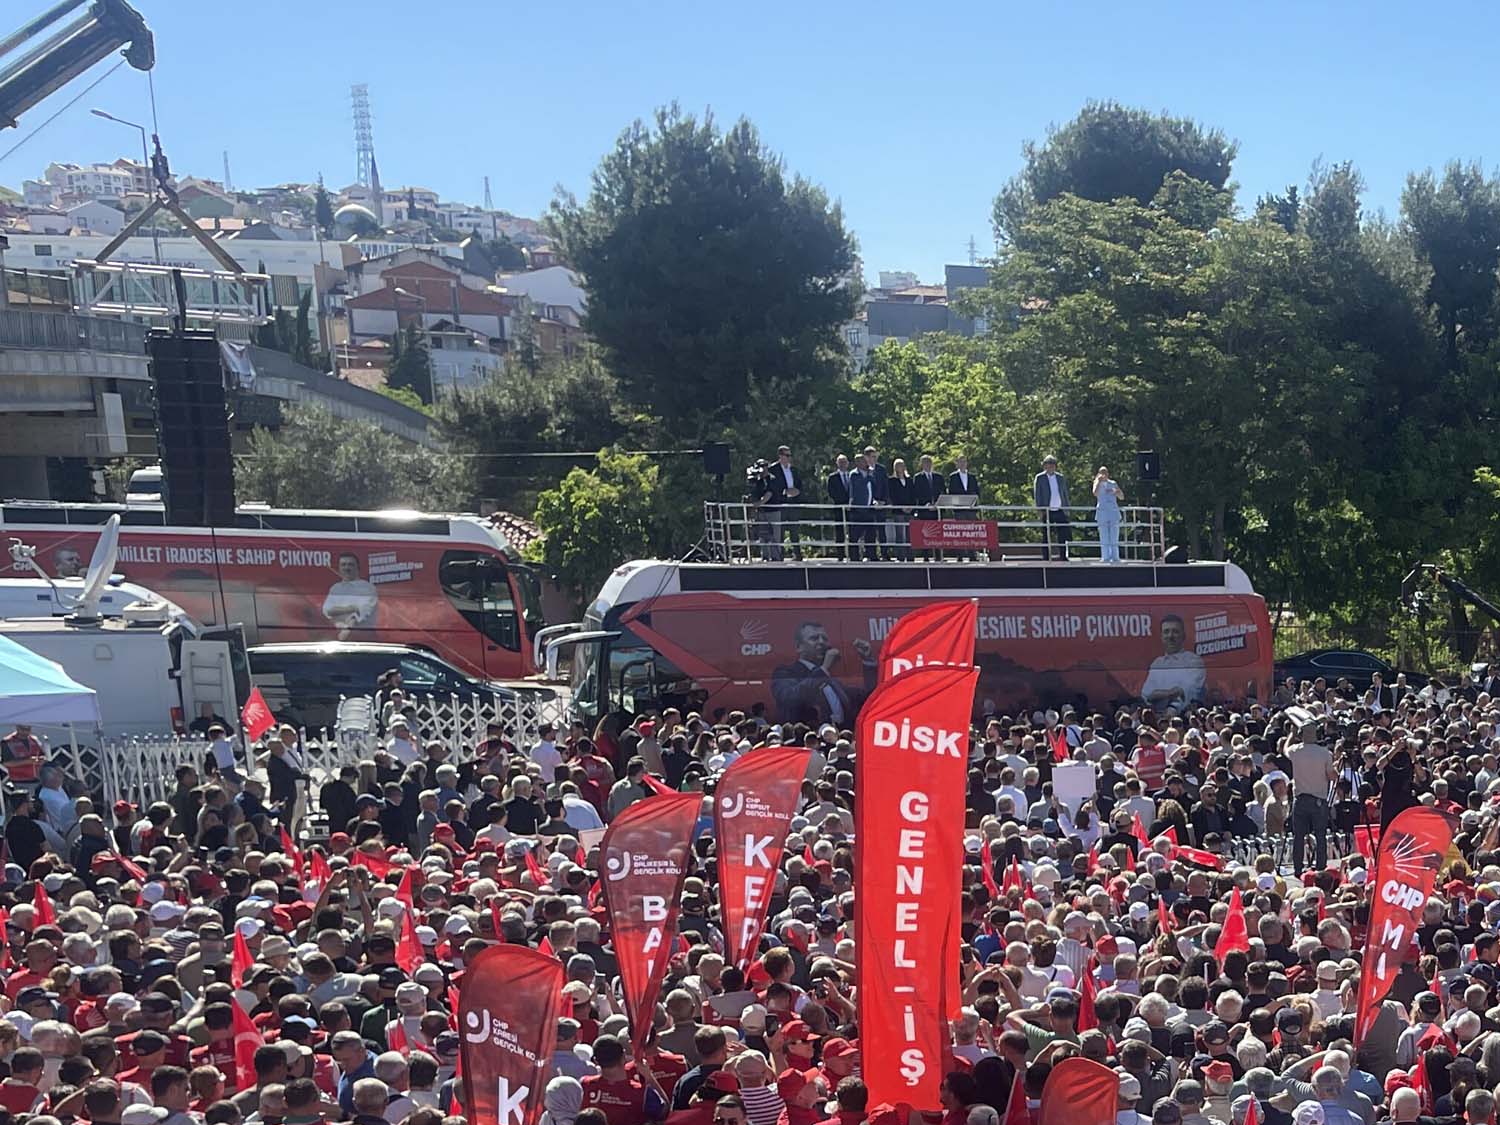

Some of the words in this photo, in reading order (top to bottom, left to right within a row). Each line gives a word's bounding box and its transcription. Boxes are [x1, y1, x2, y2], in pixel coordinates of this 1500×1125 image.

[117, 546, 162, 563] MİLLET
[166, 546, 233, 565] İRADESİNE
[236, 548, 276, 566] SAHİP
[279, 549, 331, 569] ÇIKIYOR
[1031, 615, 1082, 638] SAHİP
[1086, 615, 1152, 641] ÇIKIYOR
[741, 644, 771, 655] CHP
[873, 718, 962, 757] DİSK
[1381, 880, 1424, 911] CHP
[492, 1018, 509, 1030] CHP
[493, 1027, 518, 1045] KARESİ
[493, 1037, 525, 1057] GENÇLİK
